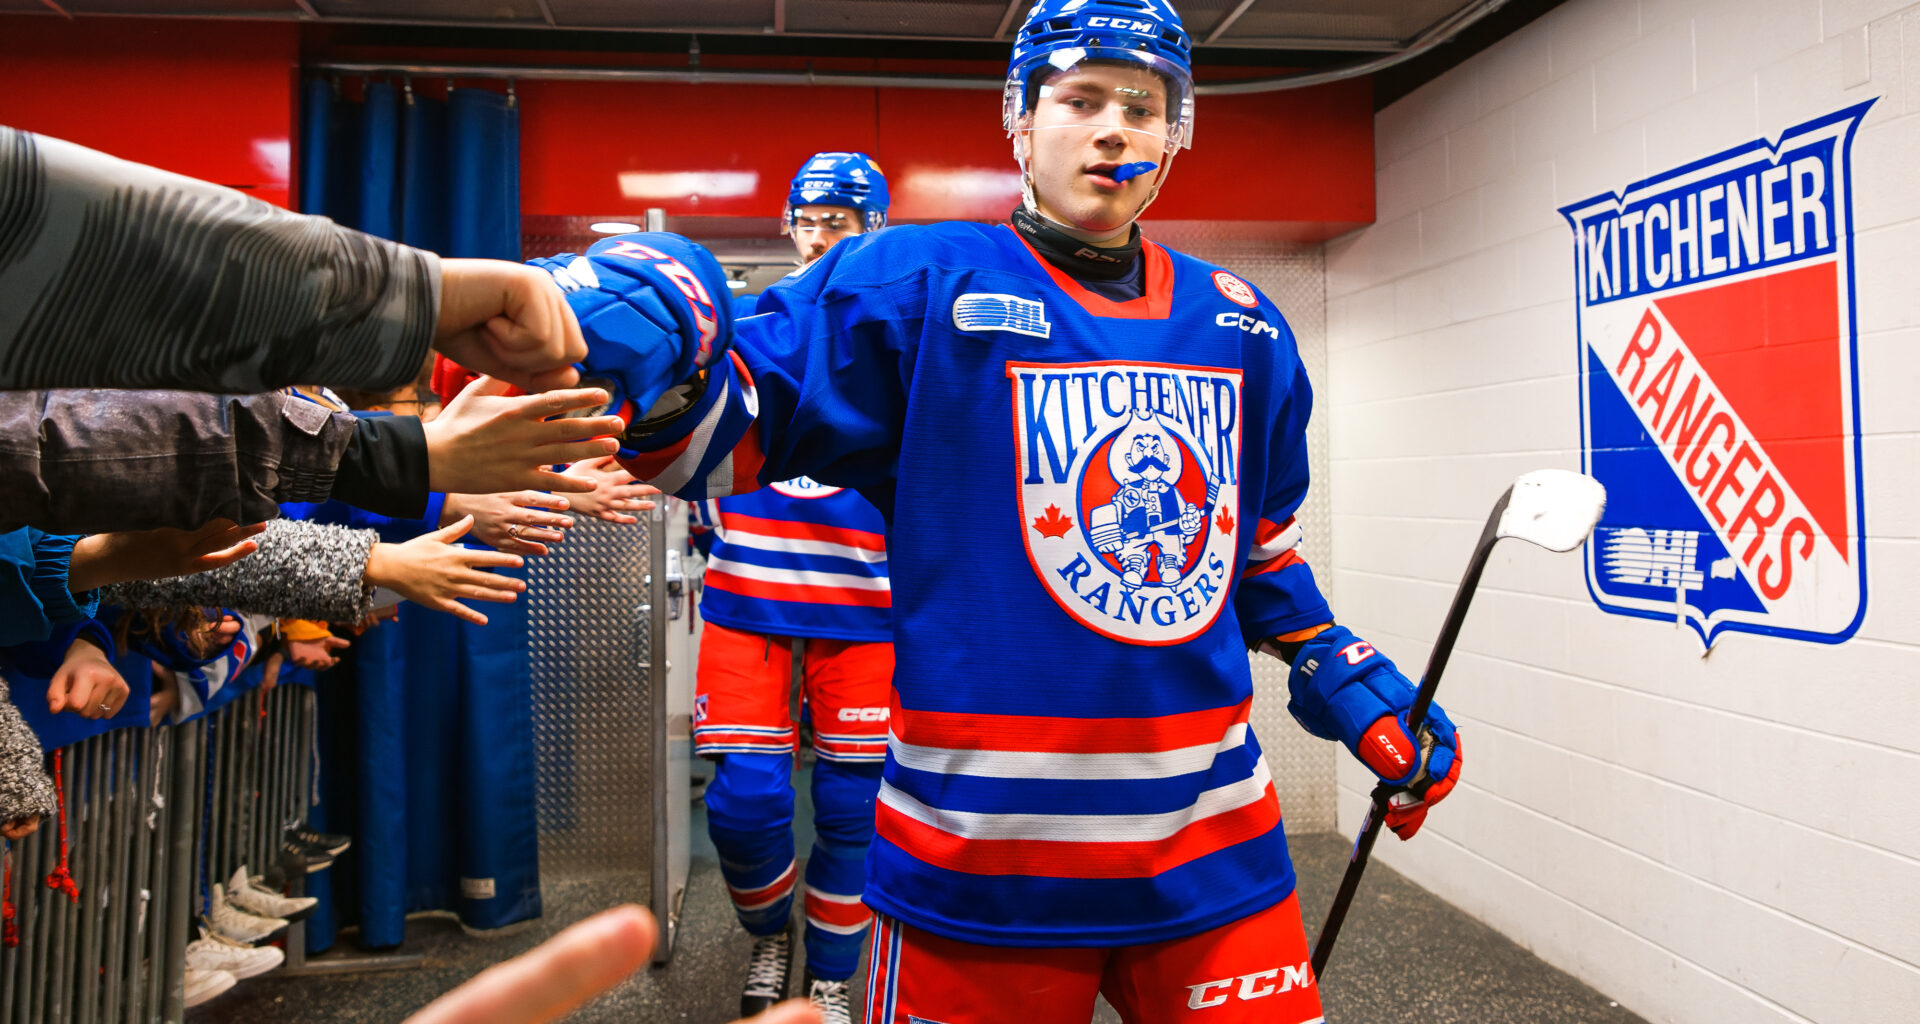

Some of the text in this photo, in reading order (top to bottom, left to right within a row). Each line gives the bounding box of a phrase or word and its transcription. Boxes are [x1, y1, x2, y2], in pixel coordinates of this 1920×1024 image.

[1087, 16, 1153, 33] CCM
[1586, 154, 1830, 302] KITCHENER
[1215, 312, 1279, 340] CCM
[1019, 371, 1237, 485] KITCHENER
[1616, 306, 1816, 600] RANGERS
[1056, 551, 1225, 626] RANGERS
[1378, 734, 1408, 765] CCM
[1184, 961, 1308, 1010] CCM
